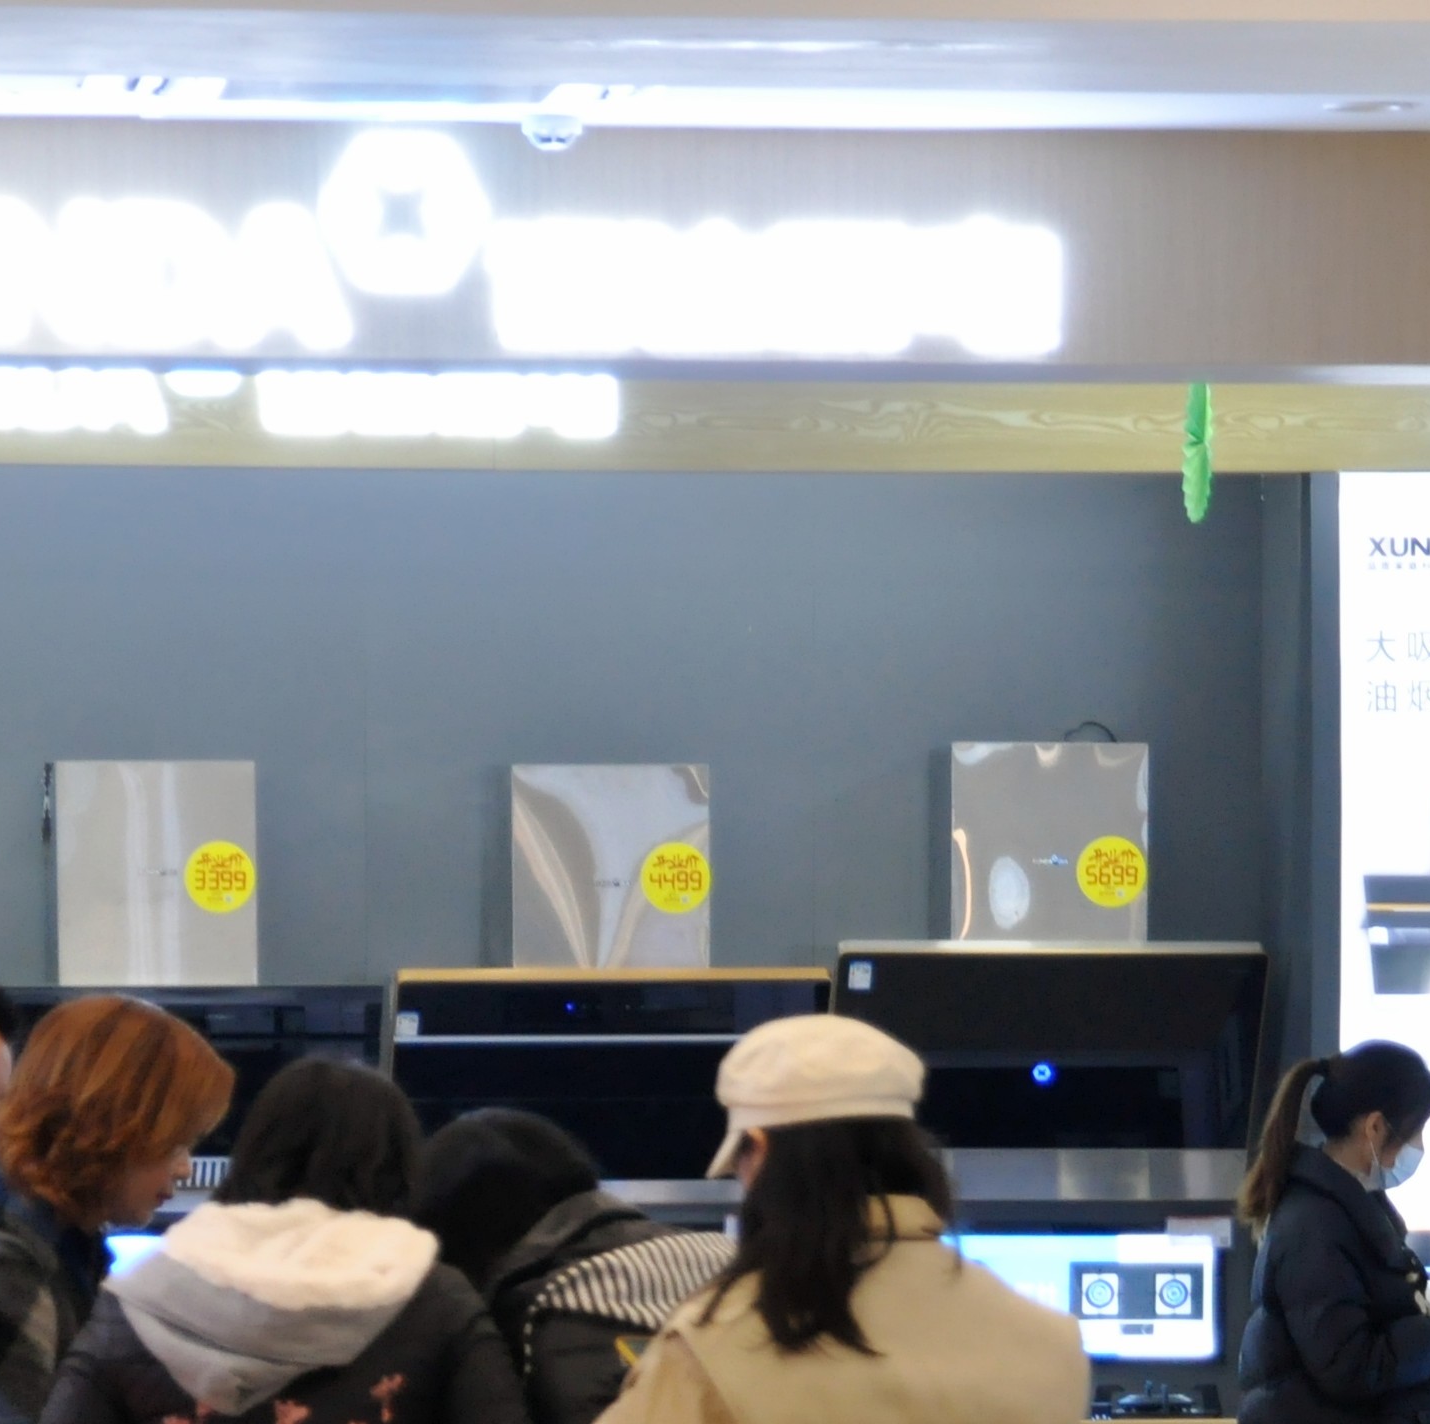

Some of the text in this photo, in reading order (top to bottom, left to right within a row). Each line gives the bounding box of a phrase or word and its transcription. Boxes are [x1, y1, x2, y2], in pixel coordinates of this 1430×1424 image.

[195, 870, 247, 891] 3399
[649, 870, 703, 891] 4499
[1085, 865, 1139, 886] 5699
